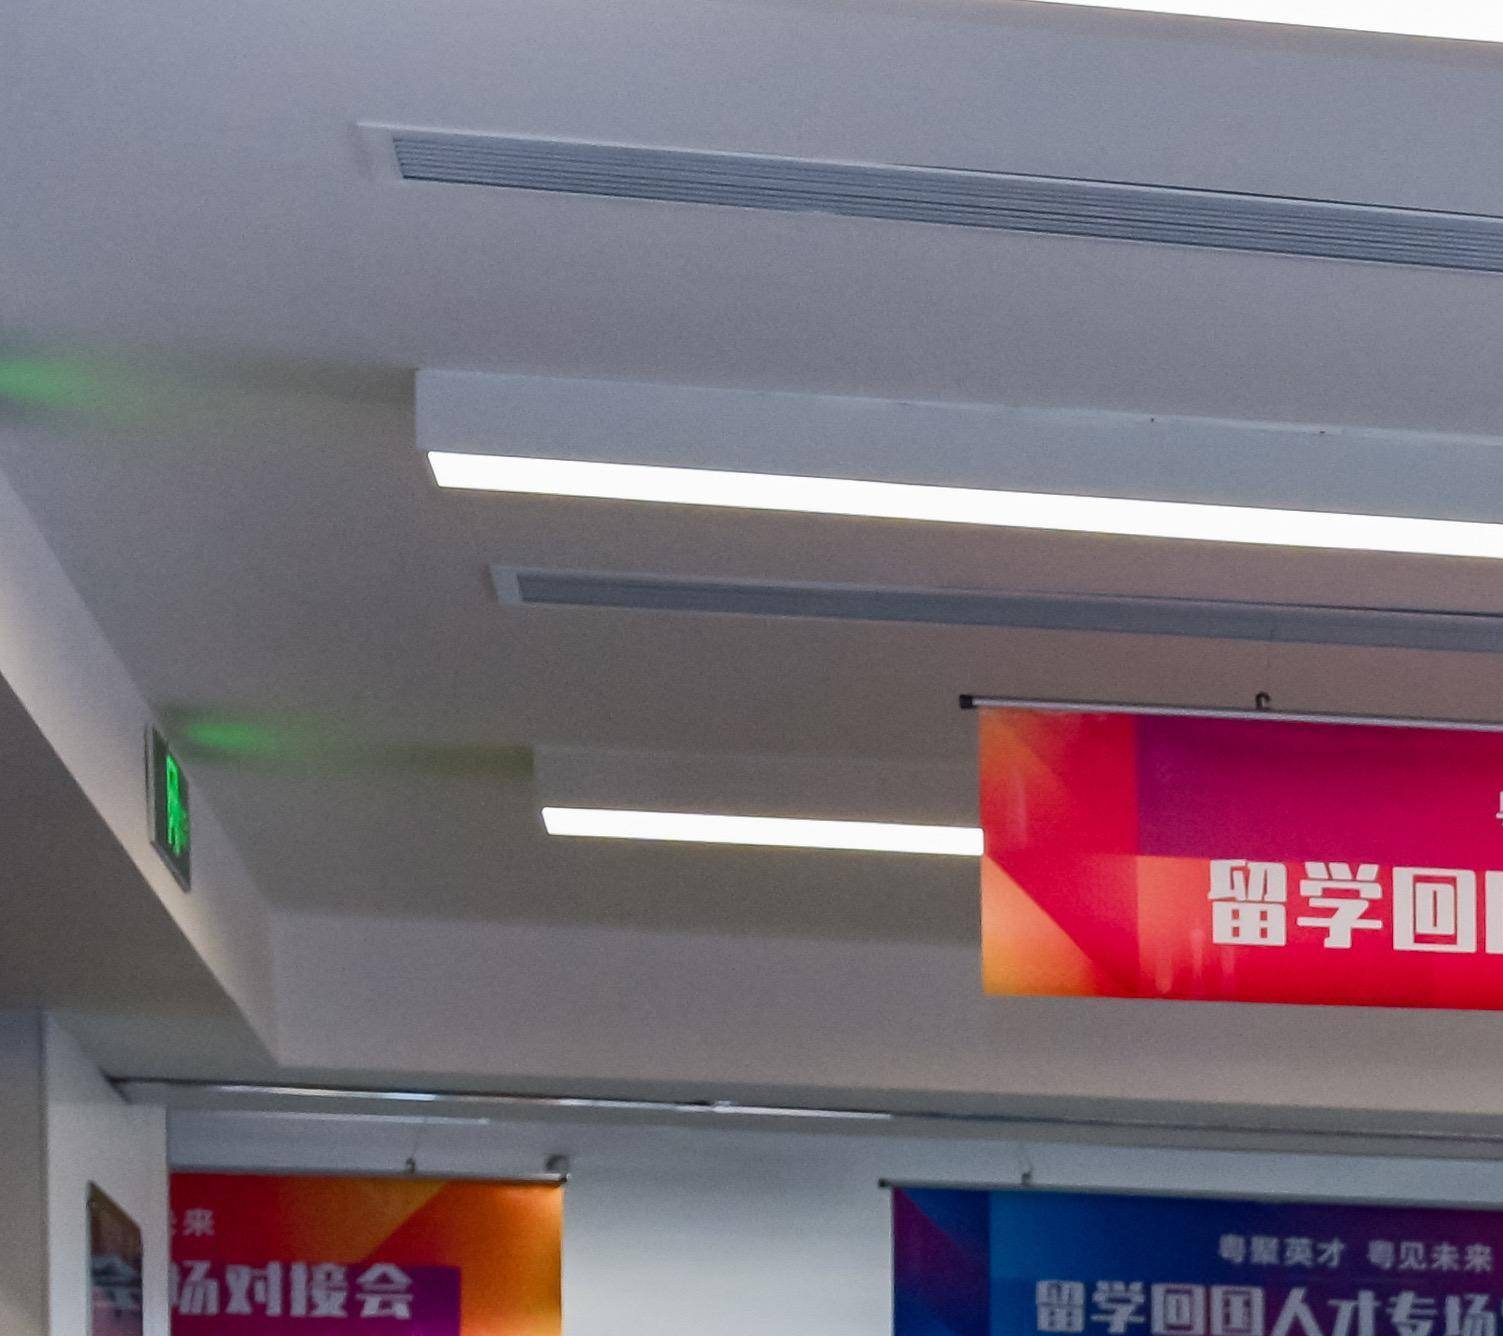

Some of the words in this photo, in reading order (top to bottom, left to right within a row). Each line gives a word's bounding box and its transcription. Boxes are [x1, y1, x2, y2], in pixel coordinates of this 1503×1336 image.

[1218, 1233, 1346, 1268] 粤聚英才
[1367, 1239, 1493, 1273] 粤见未来
